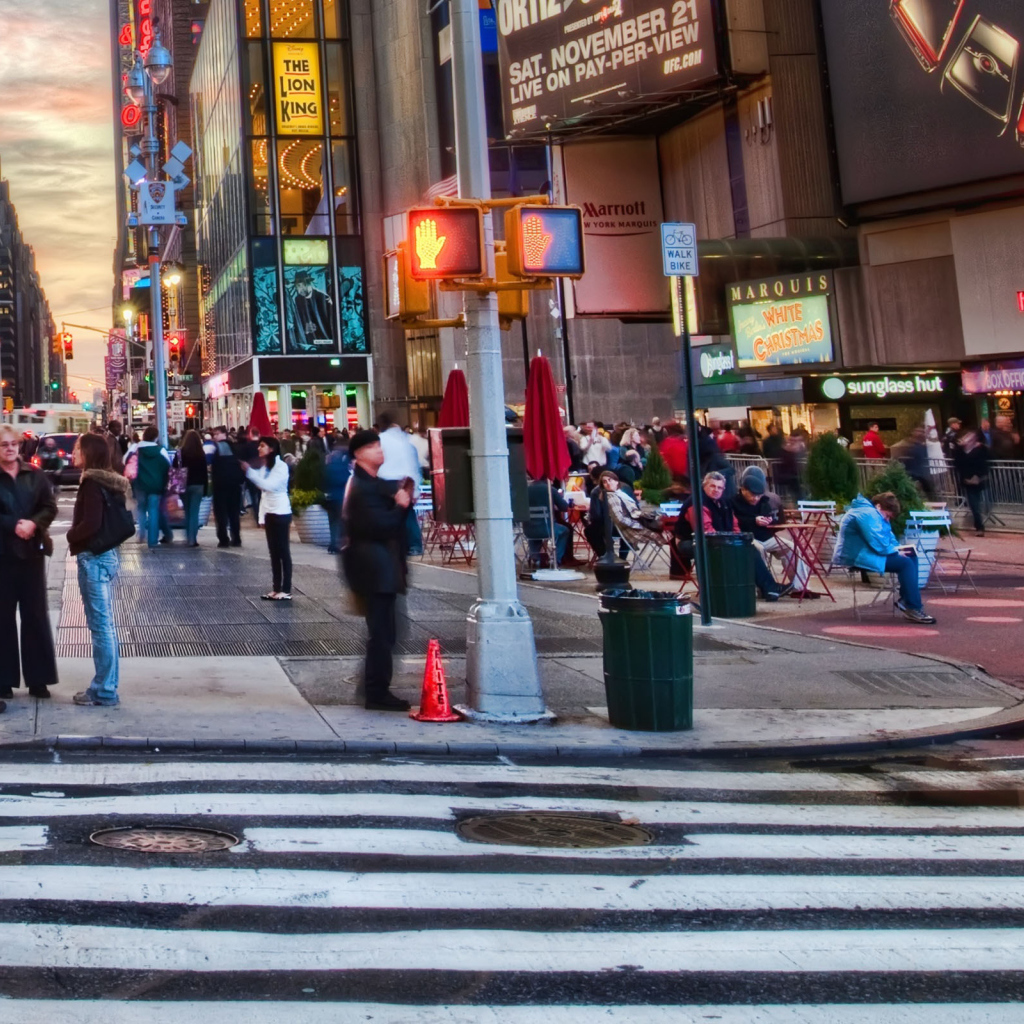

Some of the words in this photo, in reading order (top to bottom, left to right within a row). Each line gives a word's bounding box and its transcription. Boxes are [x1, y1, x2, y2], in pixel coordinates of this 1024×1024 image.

[509, 53, 546, 86] SAT.
[550, 7, 667, 71] NOVEMBER
[283, 59, 310, 72] THE
[510, 80, 543, 105] LIVE
[546, 68, 571, 92] ON
[575, 21, 700, 83] PAY-PER-VIEW
[663, 49, 702, 75] UFC.COM
[280, 76, 315, 97] LION
[281, 100, 318, 122] KING
[583, 201, 646, 218] Marriott
[619, 220, 657, 228] MARQUIS
[667, 250, 692, 259] WALK
[670, 262, 691, 270] BIKE
[731, 275, 828, 301] MARQUIS
[762, 302, 803, 327] WHITE
[753, 319, 824, 362] CHRISTMAS
[848, 376, 914, 398] sunglass
[916, 376, 943, 393] hut
[987, 372, 1004, 389] BOX
[435, 650, 444, 705] ELITE
